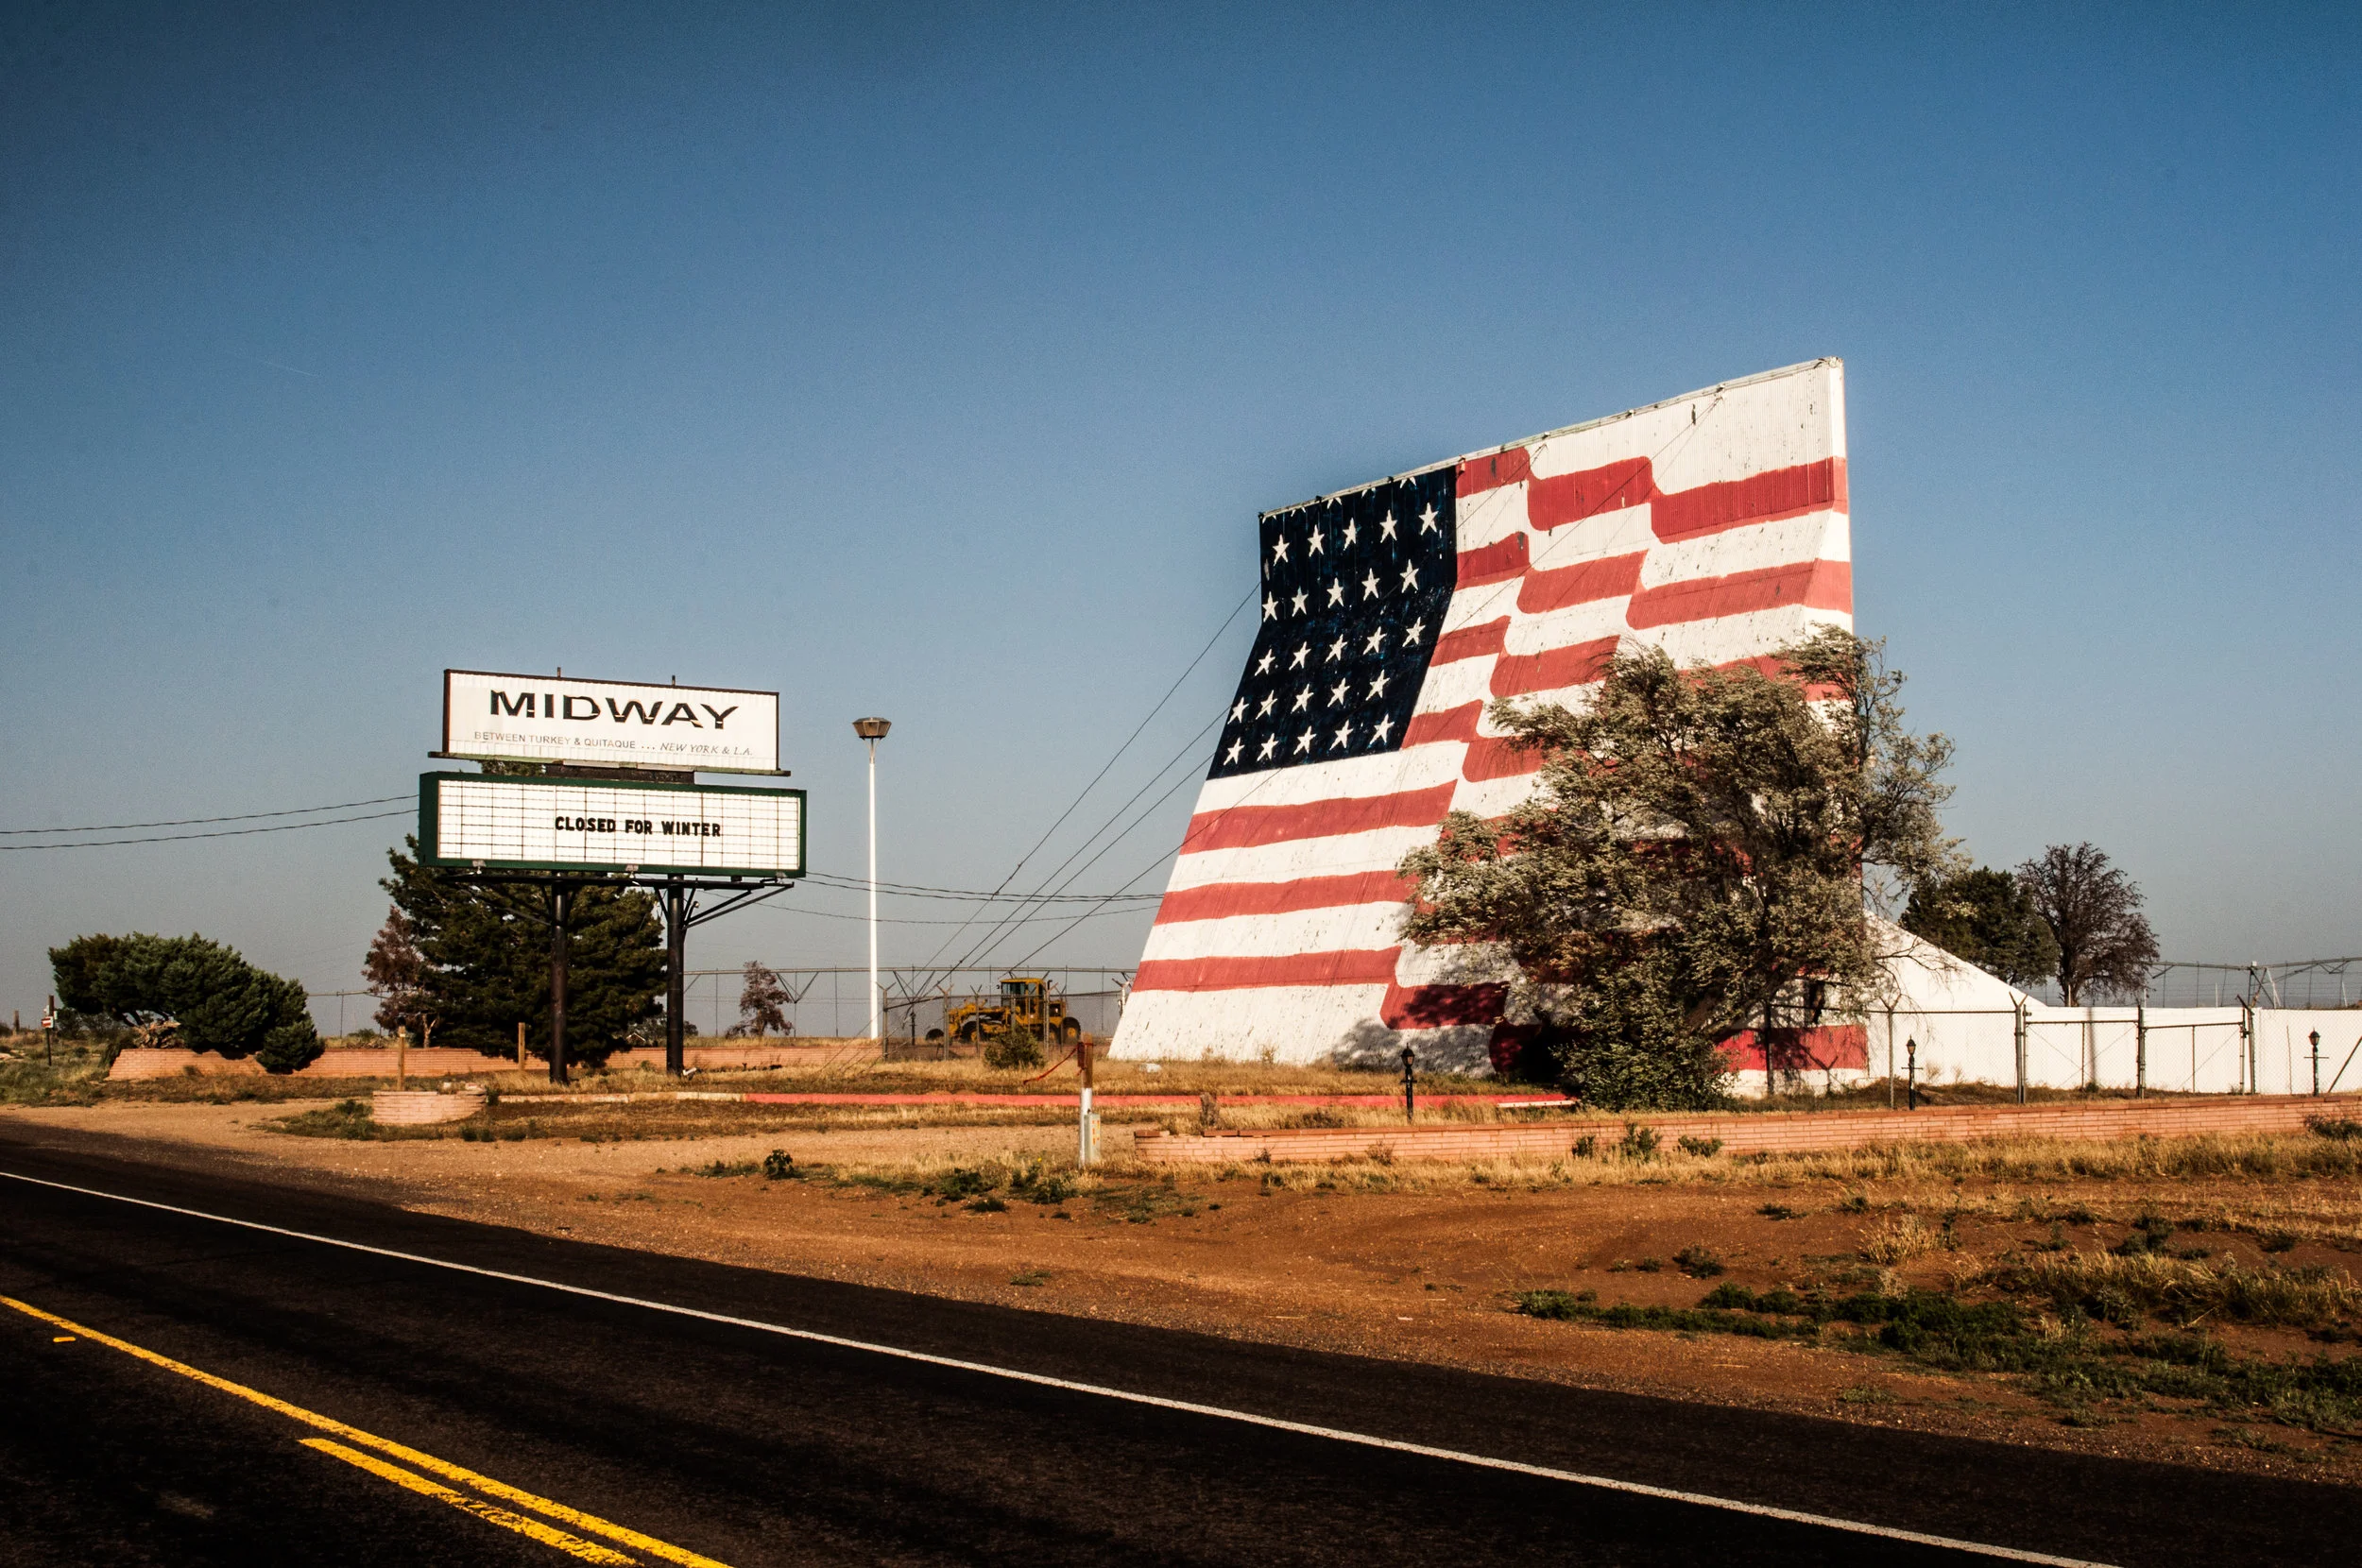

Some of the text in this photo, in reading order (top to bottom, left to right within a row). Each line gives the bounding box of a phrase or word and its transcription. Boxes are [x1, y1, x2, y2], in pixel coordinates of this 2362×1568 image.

[489, 690, 739, 730] MIDWAY
[473, 731, 526, 743] BETWEEN
[528, 734, 573, 745] TURKEY
[573, 737, 581, 745] &
[584, 738, 636, 749] QUITAQUE
[659, 742, 688, 753] NEW
[690, 743, 719, 754] YORK
[721, 745, 730, 755] &
[733, 746, 753, 756] L.A.
[555, 816, 721, 837] CLOSED FOR WINTER
